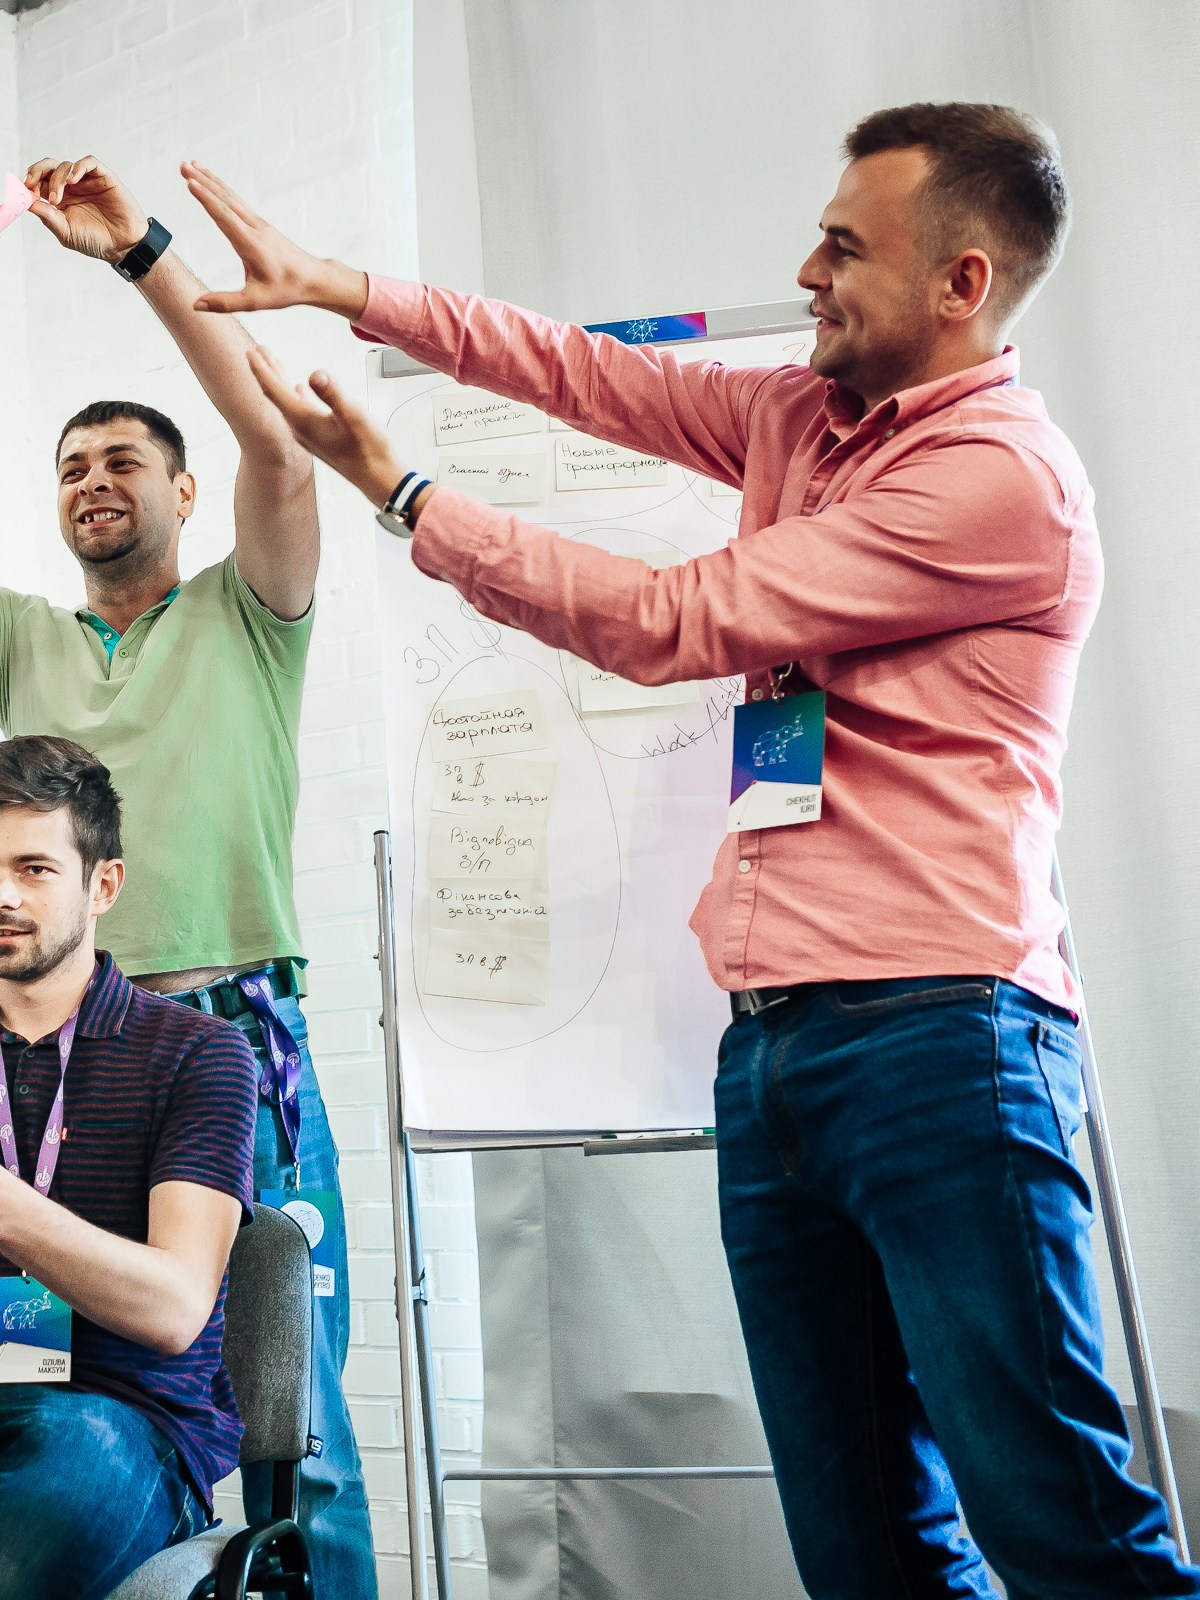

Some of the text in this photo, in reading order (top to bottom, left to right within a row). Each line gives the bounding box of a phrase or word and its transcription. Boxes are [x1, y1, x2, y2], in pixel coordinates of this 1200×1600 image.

[561, 443, 617, 457] Новые
[433, 708, 525, 728] Достойная
[447, 723, 533, 748] зарплата
[43, 1358, 66, 1366] DZIUBA
